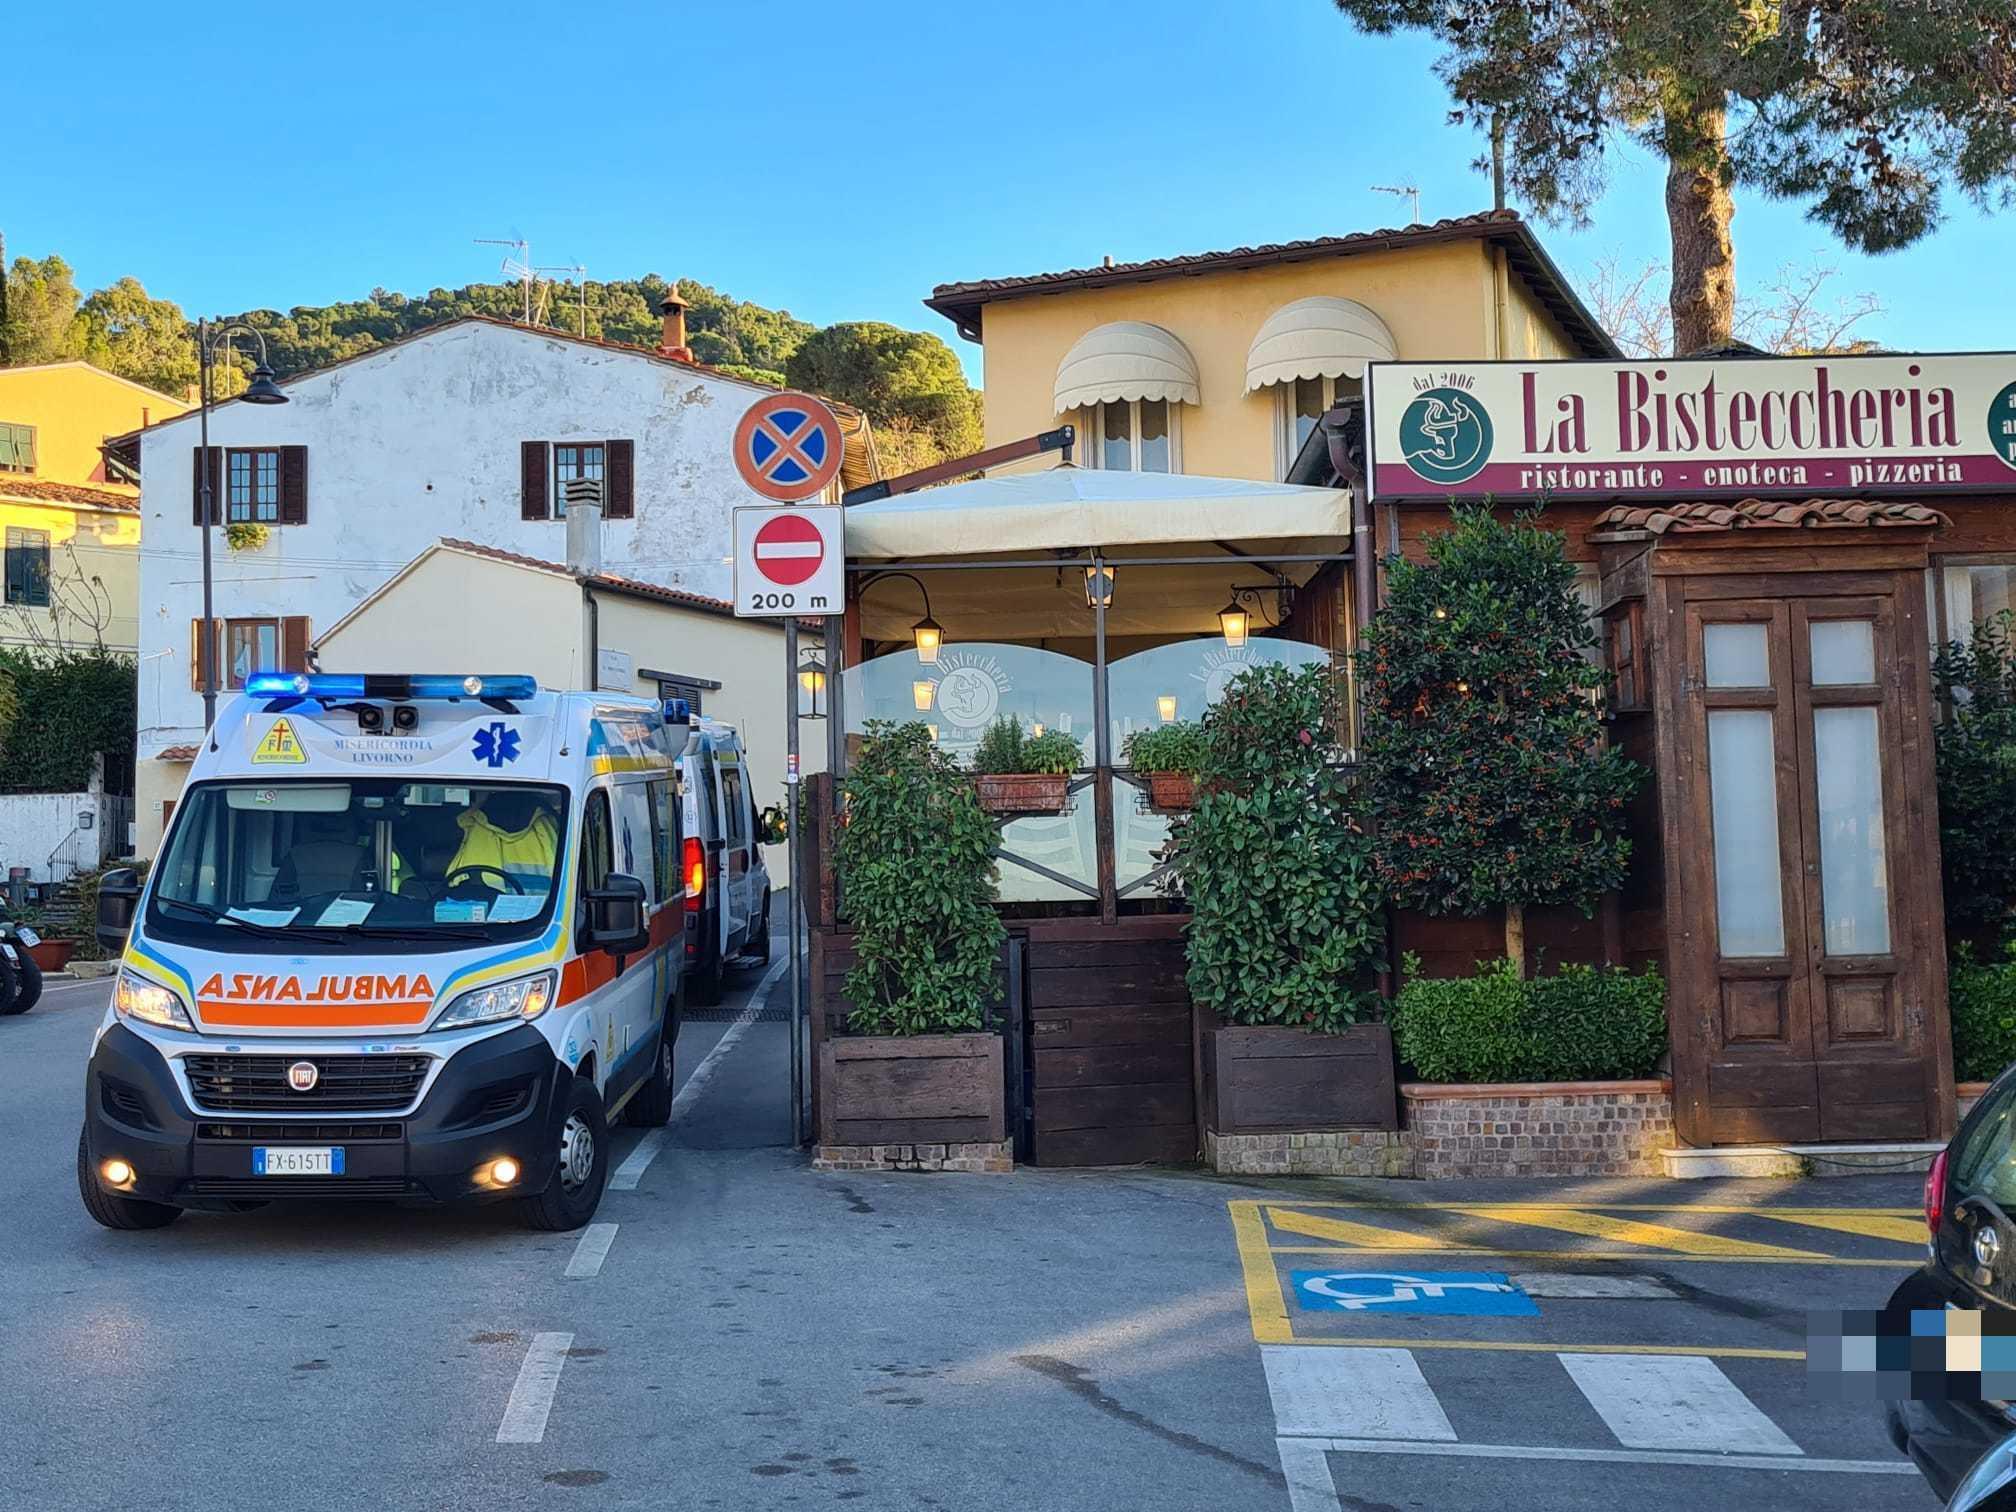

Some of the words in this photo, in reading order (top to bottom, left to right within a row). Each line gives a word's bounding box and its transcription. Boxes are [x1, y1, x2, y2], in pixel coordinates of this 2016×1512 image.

[1412, 373, 1436, 391] dal
[1440, 372, 1476, 390] 2006
[1518, 371, 1592, 454] La
[1613, 364, 1963, 453] Bisteccheria
[1520, 463, 1664, 489] ristorante
[1704, 461, 1809, 486] enoteca
[1850, 457, 1964, 488] pizzeria
[752, 593, 795, 609] 200
[810, 596, 827, 608] m
[335, 739, 433, 751] MISERICORDIA
[352, 753, 414, 763] LIVORNO
